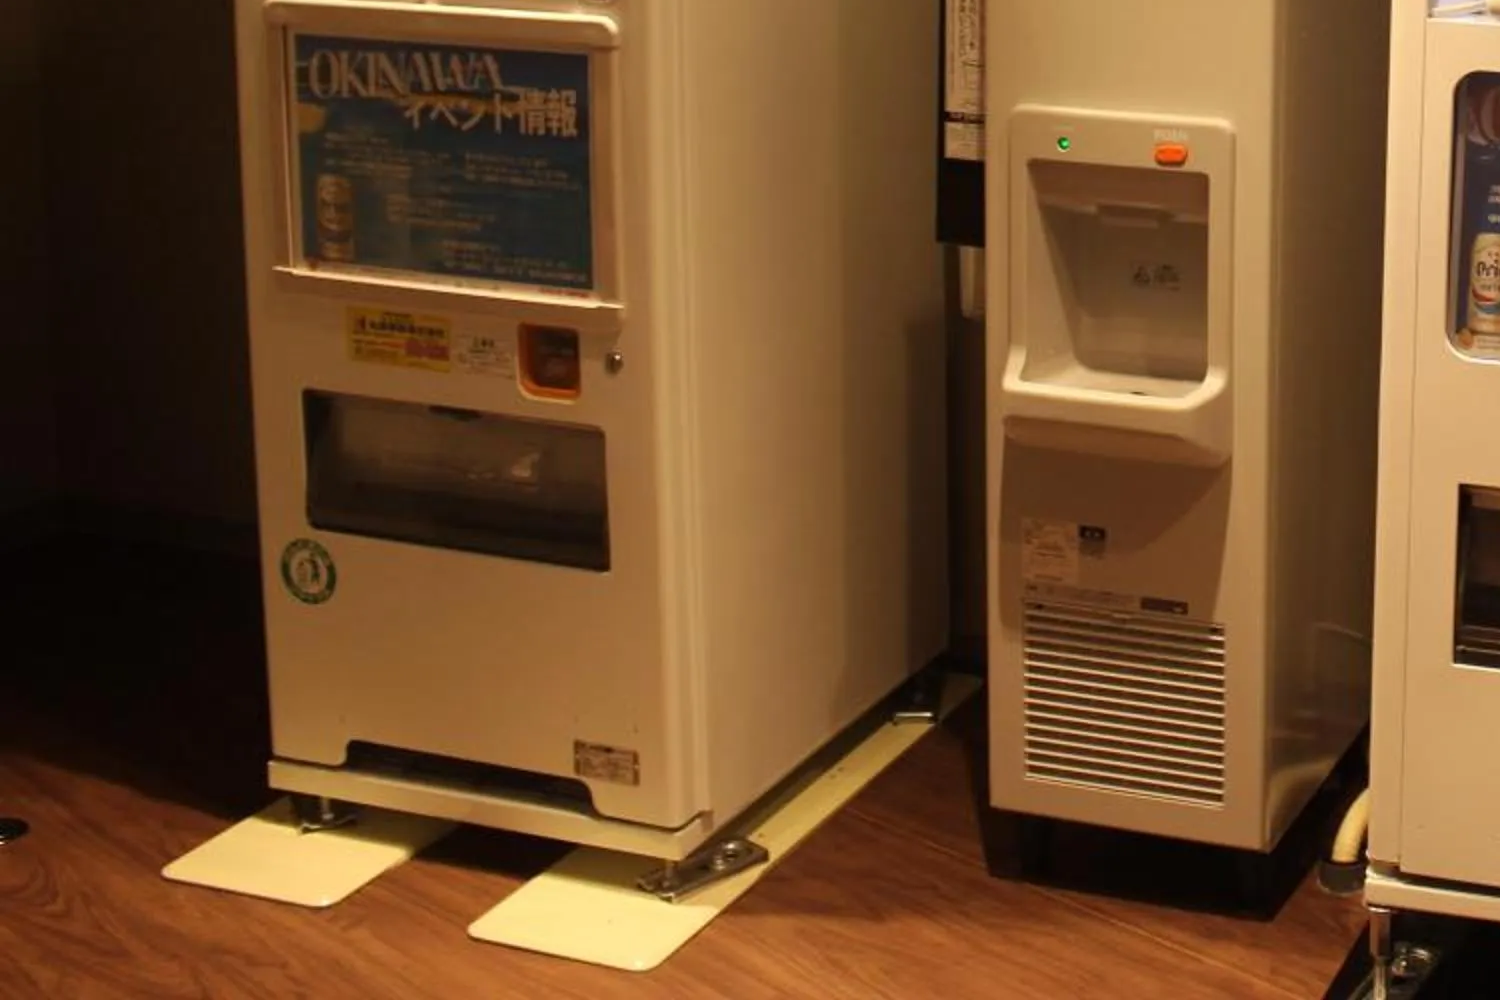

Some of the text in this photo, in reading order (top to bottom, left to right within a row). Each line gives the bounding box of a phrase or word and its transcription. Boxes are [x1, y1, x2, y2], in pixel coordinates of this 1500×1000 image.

[309, 48, 503, 98] OKINAWA
[404, 88, 578, 137] イベント情報
